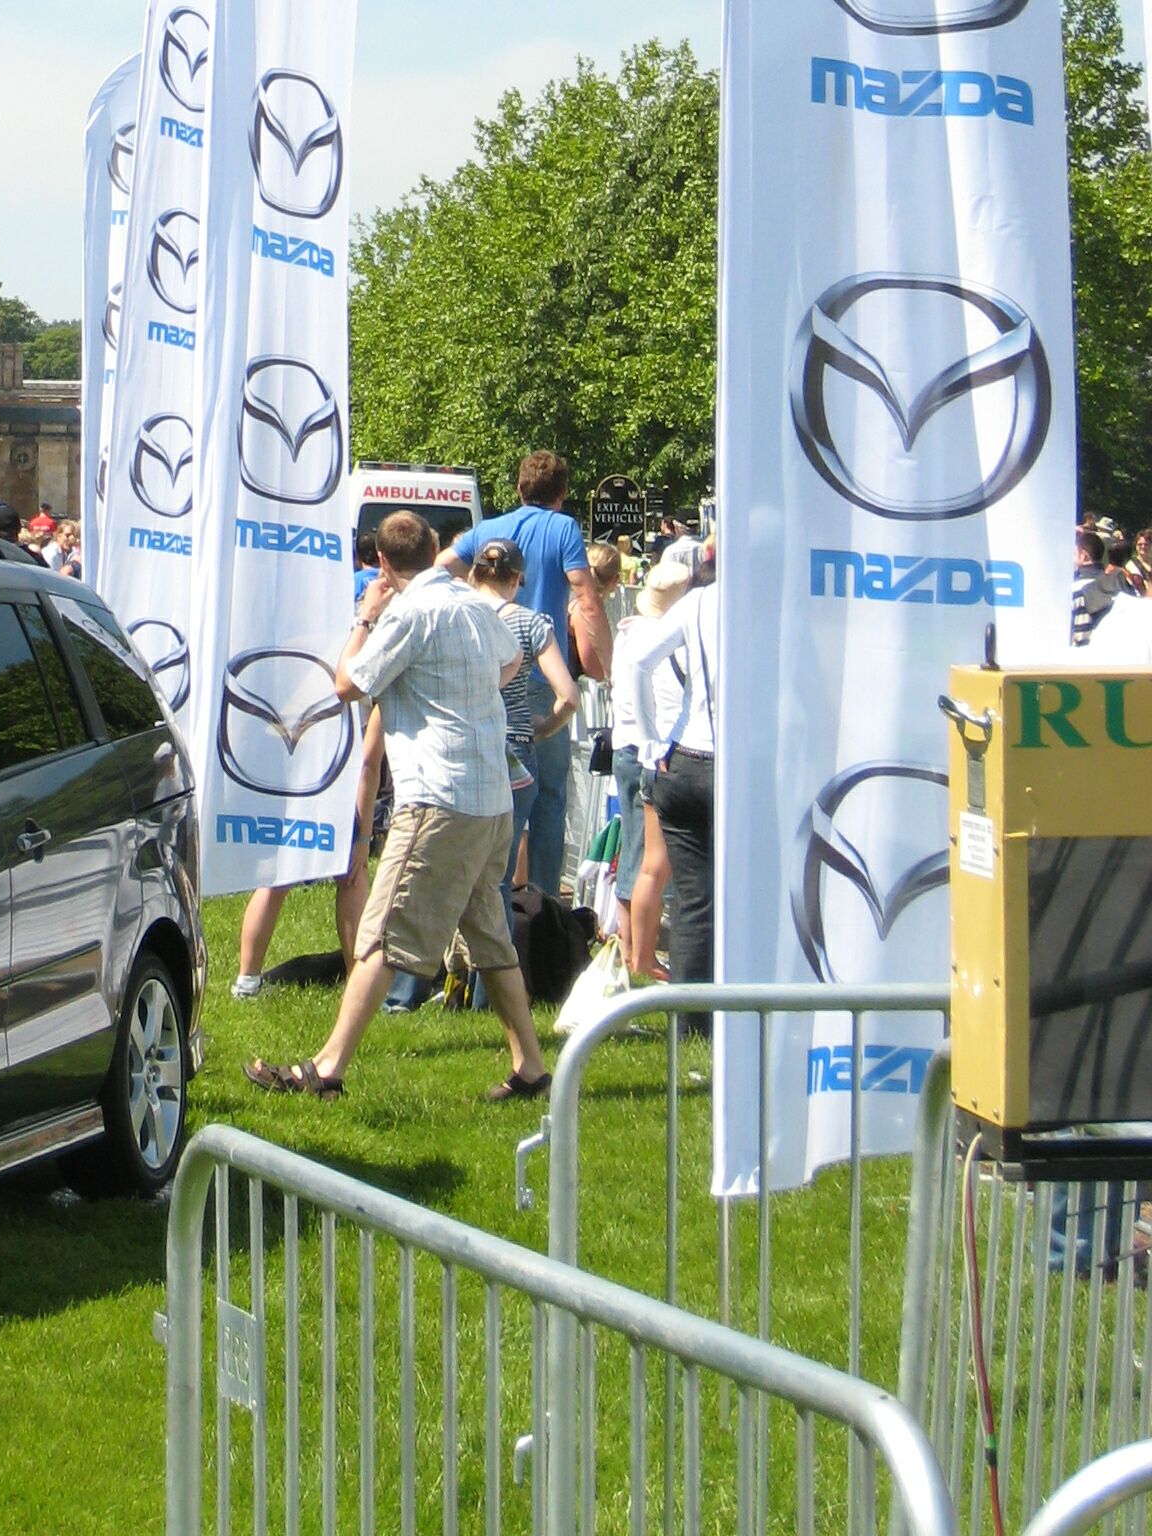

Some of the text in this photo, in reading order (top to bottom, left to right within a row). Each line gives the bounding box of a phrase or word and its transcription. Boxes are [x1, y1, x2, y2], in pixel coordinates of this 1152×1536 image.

[148, 320, 196, 351] mazd
[363, 485, 472, 503] AMBULANCE
[597, 503, 640, 513] EXIT ALL
[594, 513, 644, 524] VEHICLES
